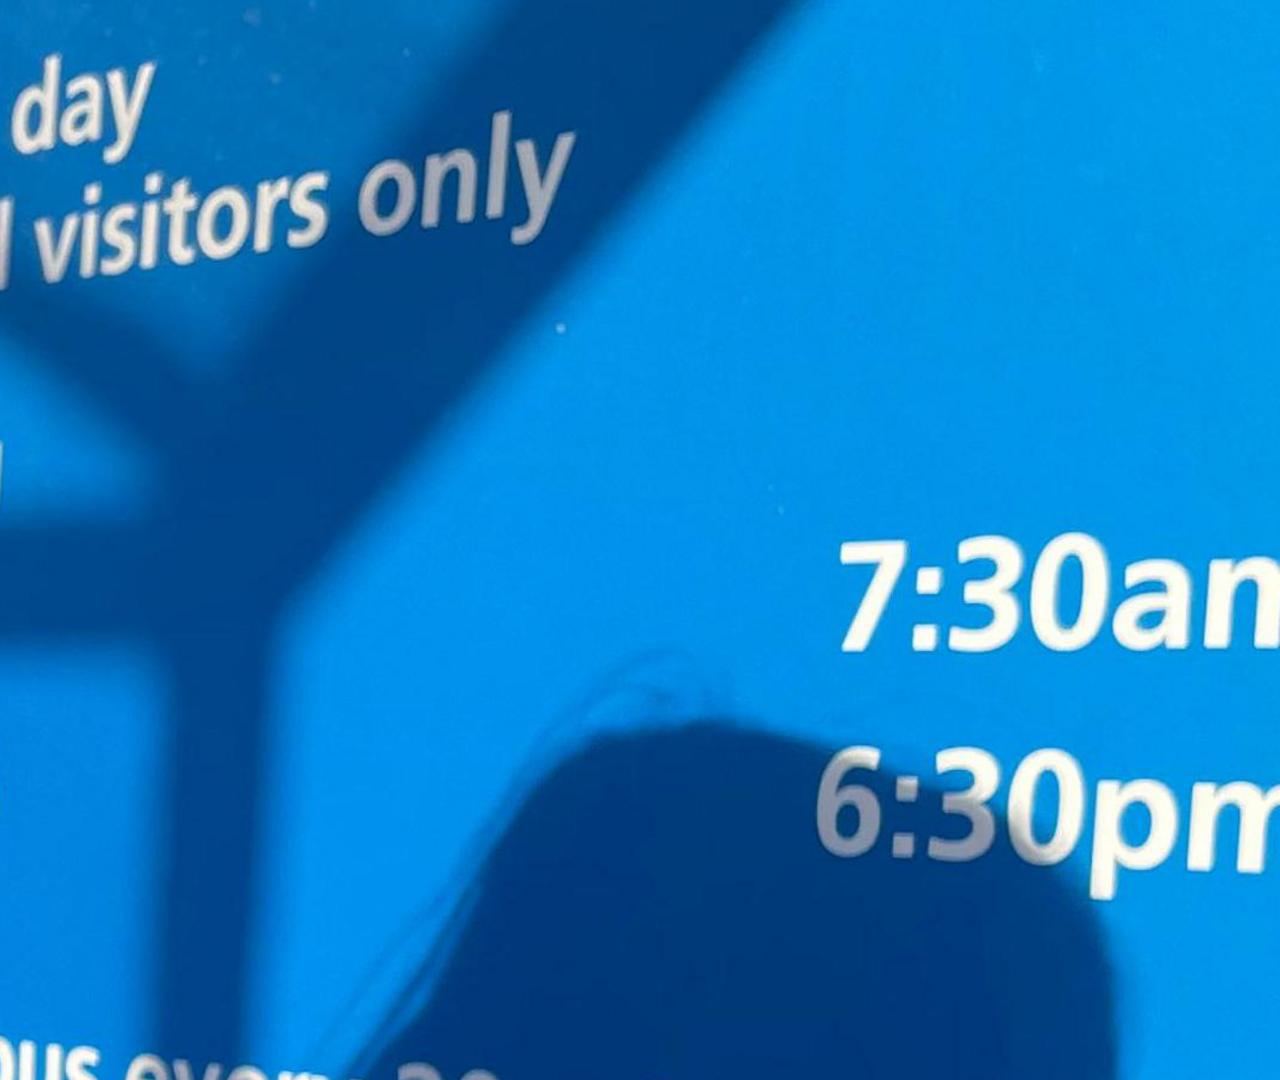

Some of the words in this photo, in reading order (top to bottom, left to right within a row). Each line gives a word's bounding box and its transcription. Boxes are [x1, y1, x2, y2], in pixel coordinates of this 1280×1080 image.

[10, 53, 157, 165] day
[34, 171, 329, 284] visitors
[358, 110, 576, 246] only
